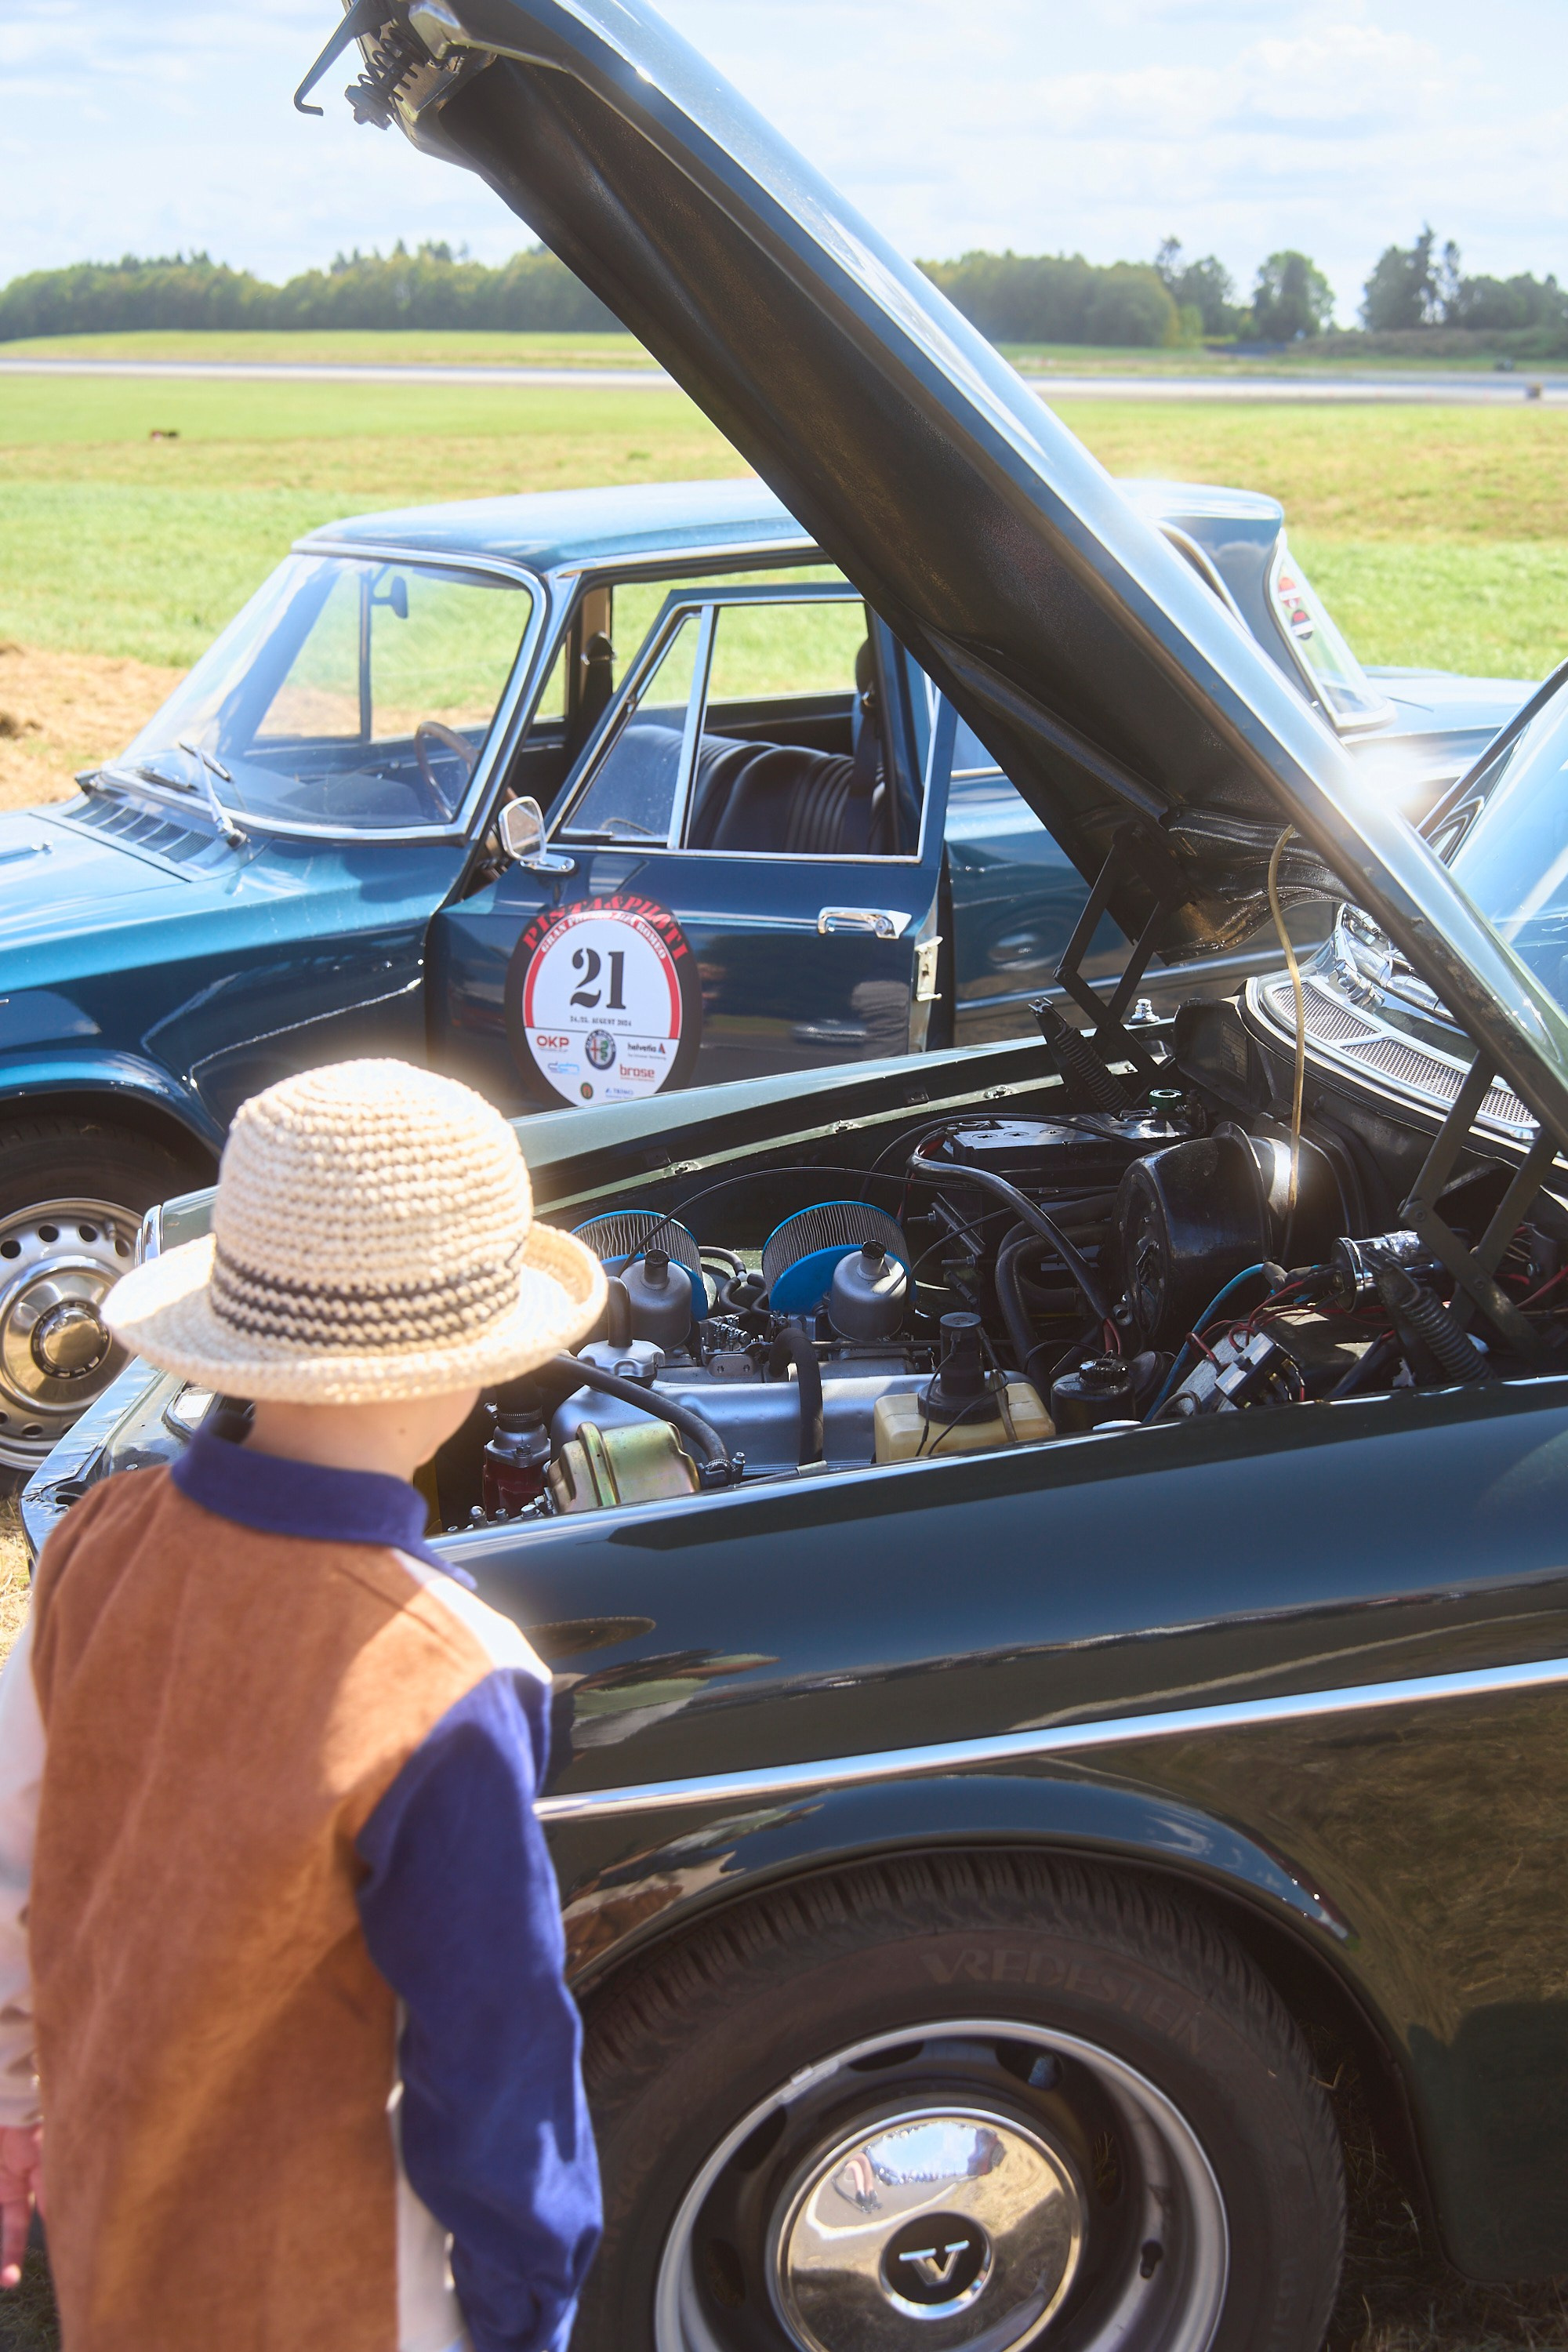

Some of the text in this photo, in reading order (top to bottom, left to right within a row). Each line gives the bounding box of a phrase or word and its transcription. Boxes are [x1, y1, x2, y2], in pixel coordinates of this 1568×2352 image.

[541, 924, 567, 953] GRAN
[636, 920, 667, 960] ROMEO
[570, 947, 626, 1010] 21
[536, 1036, 570, 1048] OKP
[627, 1042, 657, 1053] helvetia
[619, 1063, 655, 1079] brose
[920, 1948, 1209, 2056] VREDESTEIN
